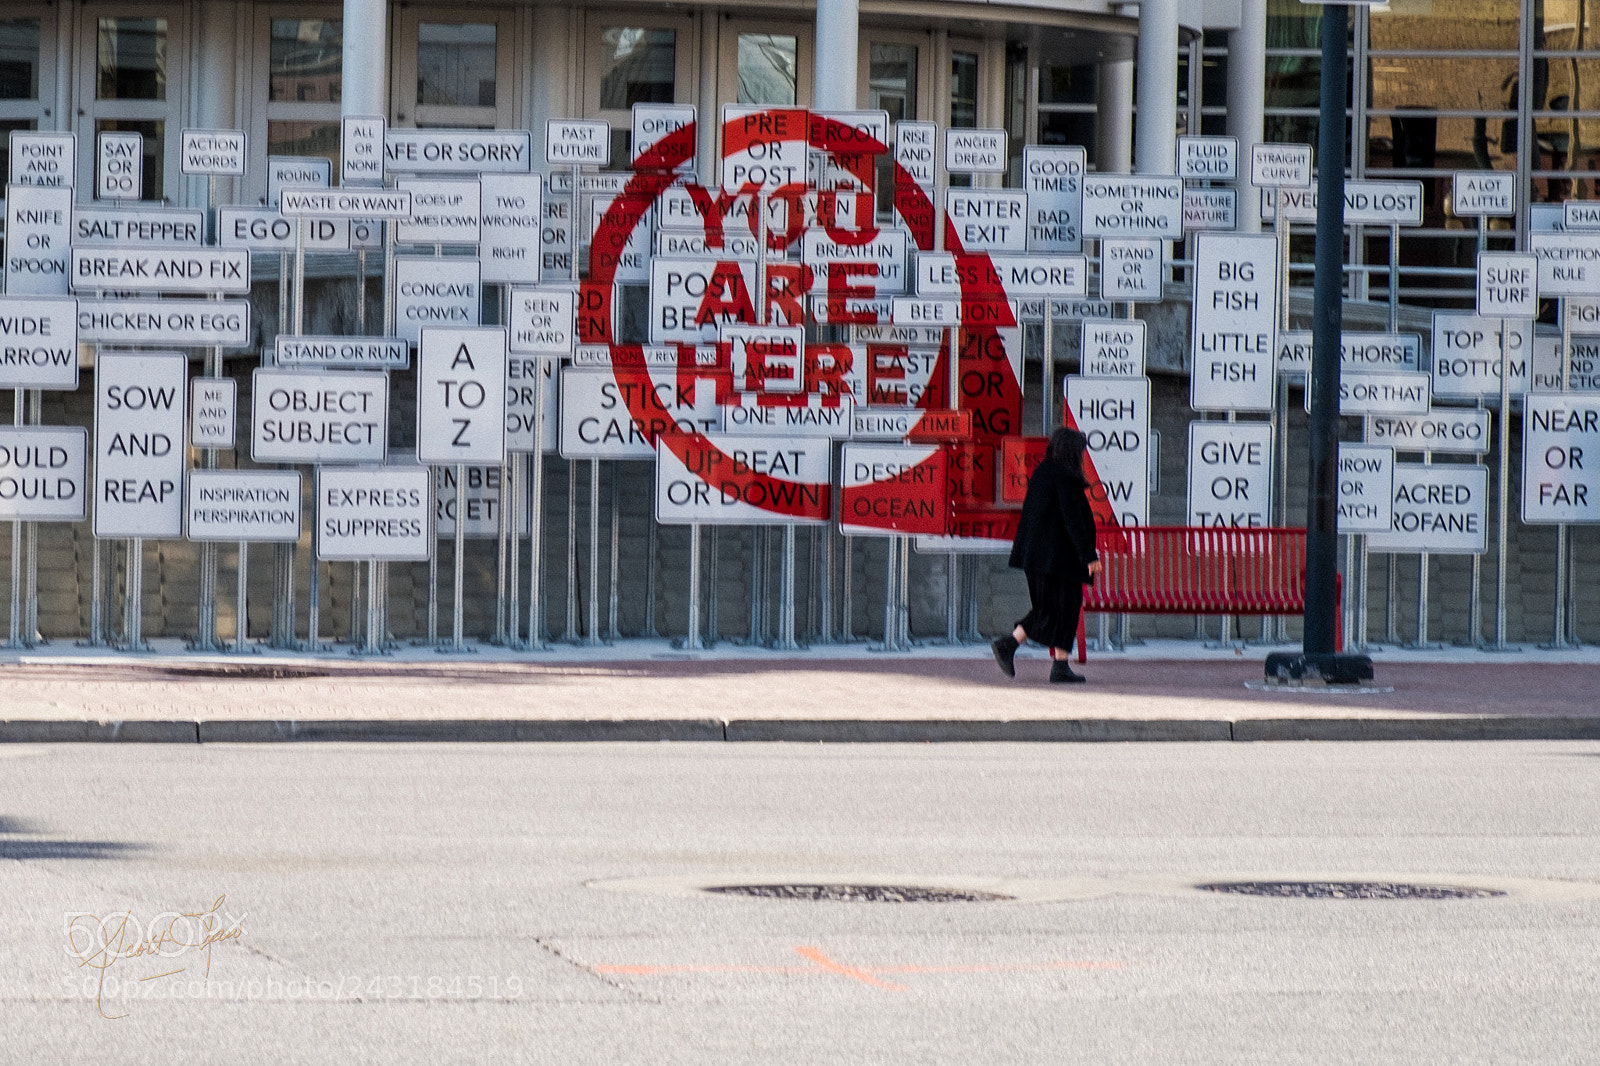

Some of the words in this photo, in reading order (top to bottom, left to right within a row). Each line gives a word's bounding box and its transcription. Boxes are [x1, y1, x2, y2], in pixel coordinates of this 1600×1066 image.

[354, 126, 374, 138] ALL
[642, 119, 685, 134] OPEN
[744, 115, 787, 135] PRE
[826, 123, 881, 142] ROOT
[562, 127, 595, 140] PAST
[903, 130, 930, 144] RISE
[105, 142, 136, 158] SAY
[188, 138, 239, 152] ACTION
[355, 143, 372, 155] OR
[638, 141, 688, 156] CLOSE
[747, 140, 782, 160] OR
[955, 136, 997, 149] ANGER
[1188, 144, 1227, 157] FLUID
[21, 144, 64, 158] POINT
[424, 143, 451, 161] OR
[459, 143, 524, 162] SORRY
[553, 143, 601, 159] FUTURE
[901, 149, 931, 161] AND
[955, 153, 996, 165] DREAD
[1257, 153, 1307, 165] STRAIGHT
[27, 160, 58, 172] AND
[107, 159, 132, 174] OR
[188, 154, 237, 168] WORDS
[346, 160, 380, 172] NONE
[1029, 160, 1080, 176] GOOD
[1187, 160, 1228, 173] SOLID
[277, 170, 321, 182] ROUND
[734, 165, 797, 186] POST
[1262, 169, 1300, 179] CURVE
[106, 177, 133, 191] DO
[1032, 177, 1077, 192] TIMES
[1085, 184, 1179, 200] SOMETHING
[1479, 180, 1501, 190] LOT
[287, 196, 332, 210] WASTE
[339, 197, 360, 210] OR
[363, 198, 405, 211] WANT
[415, 194, 447, 207] GOES
[495, 196, 525, 209] TWO
[669, 199, 711, 217] FEW
[1121, 201, 1143, 212] OR
[1373, 195, 1416, 211] LOST
[1471, 197, 1508, 208] LITTLE
[683, 182, 880, 250] YOU
[953, 200, 1021, 218] ENTER
[1038, 209, 1070, 224] BAD
[16, 209, 63, 226] KNIFE
[482, 215, 539, 227] WRONGS
[596, 212, 647, 227] TRUTH
[1095, 215, 1168, 230] NOTHING
[78, 219, 123, 239] SALT
[127, 222, 197, 240] PEPPER
[234, 219, 290, 240] EGO
[310, 219, 335, 241] ID
[965, 225, 1009, 243] EXIT
[1031, 226, 1076, 241] TIMES
[27, 234, 50, 249] OR
[610, 232, 633, 247] OR
[492, 248, 527, 260] RIGHT
[816, 243, 874, 258] BREATH
[878, 245, 893, 258] IN
[1110, 247, 1153, 261] STAND
[10, 258, 65, 275] SPOON
[79, 258, 148, 277] BREAK
[154, 259, 203, 278] AND
[210, 260, 242, 279] FIX
[601, 253, 642, 268] DARE
[810, 263, 866, 278] BREATH
[868, 264, 900, 278] OUT
[930, 266, 977, 284] LESS
[987, 267, 1003, 285] IS
[1011, 267, 1075, 285] MORE
[1123, 263, 1142, 275] OR
[1219, 262, 1254, 281] BIG
[1487, 268, 1529, 285] SURF
[1554, 267, 1585, 280] RULE
[401, 282, 474, 297] CONCAVE
[668, 272, 743, 298] POST
[1117, 278, 1146, 290] FALL
[695, 261, 878, 325] ARE
[1213, 291, 1258, 310] FISH
[1486, 287, 1530, 304] TURF
[406, 305, 469, 321] CONVEX
[524, 300, 559, 312] SEEN
[818, 303, 846, 316] DOT
[852, 303, 889, 317] DASH
[911, 303, 944, 321] BEE
[1073, 303, 1108, 317] FOLD
[79, 311, 161, 331] CHICKEN
[168, 313, 194, 331] OR
[201, 314, 240, 332] EGG
[532, 315, 551, 328] OR
[518, 331, 565, 344] HEARD
[890, 328, 918, 340] AND
[1095, 332, 1133, 344] HEAD
[1443, 331, 1484, 348] TOP
[727, 336, 795, 354] TYGER
[960, 334, 1005, 361] ZIG
[1201, 333, 1267, 353] LITTLE
[284, 345, 336, 360] STAND
[340, 345, 364, 360] OR
[369, 346, 401, 360] RUN
[451, 342, 475, 371] A
[1098, 348, 1128, 359] AND
[1352, 345, 1414, 364] HORSE
[732, 362, 789, 379] LAMB
[874, 353, 935, 374] EAST
[1091, 363, 1136, 374] HEART
[676, 340, 909, 407] HERE
[1211, 362, 1256, 382] FISH
[961, 371, 1004, 397] OR
[107, 386, 176, 410] SOW
[204, 390, 222, 400] ME
[269, 389, 374, 413] OBJECT
[437, 380, 485, 409] TO
[601, 383, 695, 410] STICK
[871, 383, 937, 405] WEST
[1354, 384, 1378, 399] OR
[1383, 386, 1424, 402] THAT
[200, 408, 227, 419] AND
[732, 407, 776, 425] ONE
[786, 408, 845, 426] MANY
[1080, 400, 1135, 420] HIGH
[855, 417, 907, 432] BEING
[921, 418, 960, 433] TIME
[1532, 410, 1599, 433] NEAR
[199, 425, 226, 437] YOU
[262, 420, 379, 444] SUBJECT
[451, 418, 471, 447] Z
[1375, 420, 1417, 437] STAY
[1421, 421, 1447, 438] OR
[1452, 423, 1481, 440] GO
[108, 433, 171, 456] AND
[1201, 442, 1262, 465] GIVE
[1545, 447, 1583, 469] OR
[685, 450, 722, 474] UP
[733, 451, 806, 476] BEAT
[855, 463, 938, 484] DESERT
[105, 479, 174, 504] REAP
[200, 488, 289, 501] INSPIRATION
[667, 480, 710, 506] OR
[721, 481, 819, 507] DOWN
[1211, 477, 1249, 500] OR
[1341, 481, 1363, 496] OR
[1539, 483, 1588, 506] FAR
[327, 489, 421, 507] EXPRESS
[853, 497, 935, 518] OCEAN
[194, 509, 294, 524] PERSPIRATION
[325, 519, 422, 538] SUPPRESS
